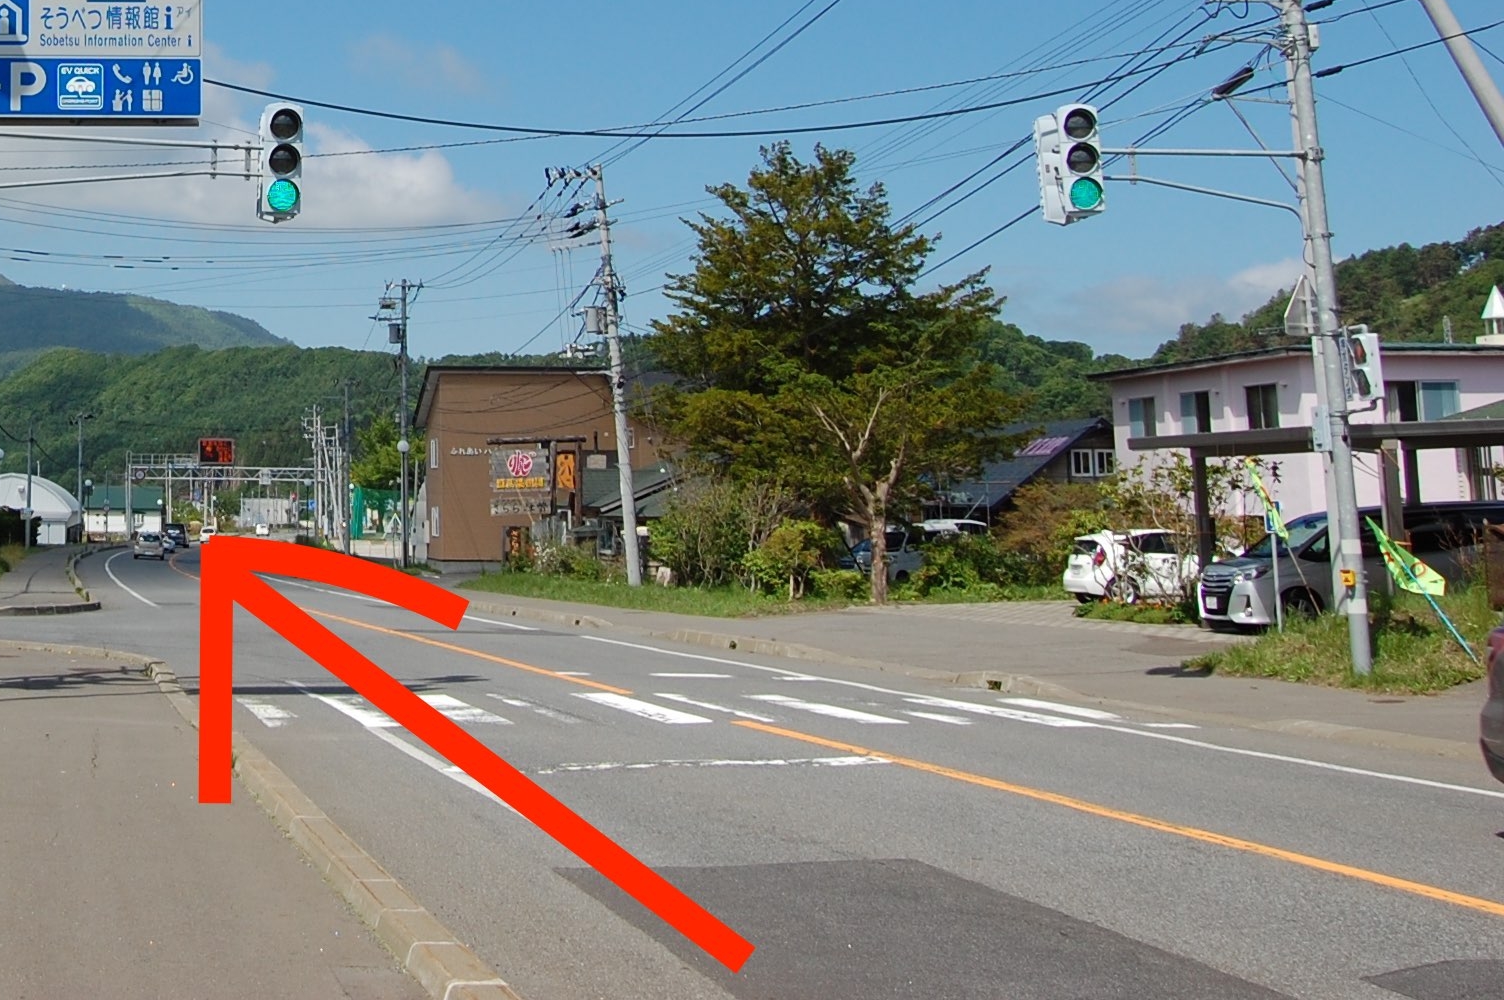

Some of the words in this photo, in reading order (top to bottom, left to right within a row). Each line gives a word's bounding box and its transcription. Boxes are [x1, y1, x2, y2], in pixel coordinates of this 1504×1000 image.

[39, 34, 80, 47] Sobetsu
[84, 34, 143, 47] Information
[148, 34, 181, 47] Center
[9, 62, 47, 112] P
[450, 446, 493, 456] ふれあいハ
